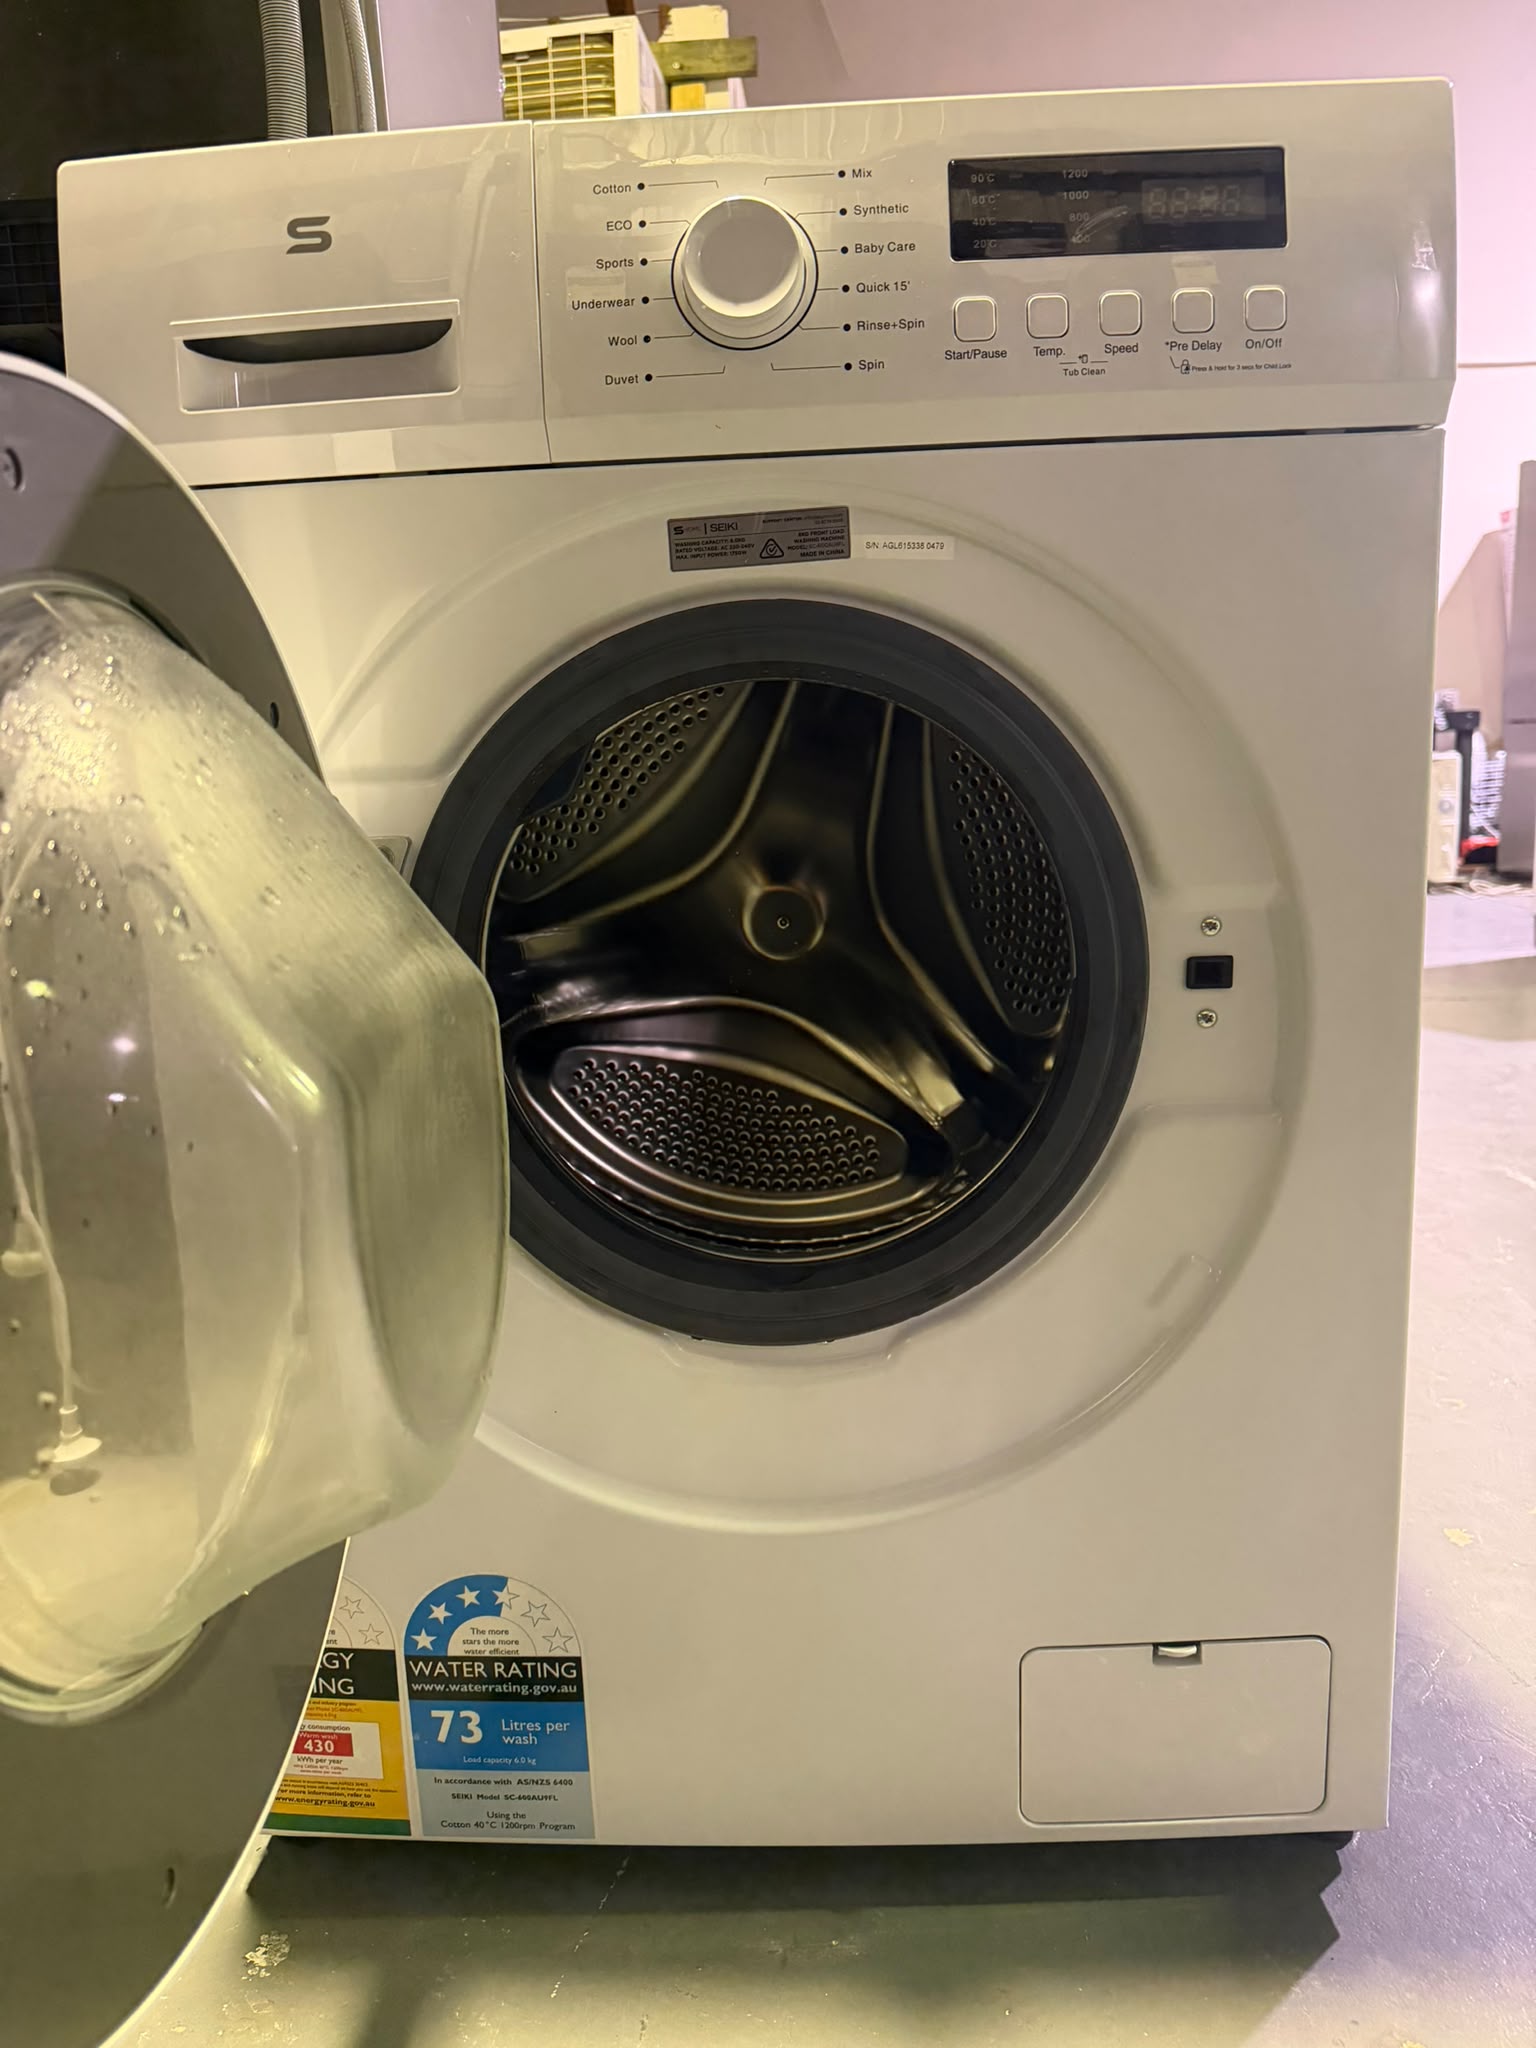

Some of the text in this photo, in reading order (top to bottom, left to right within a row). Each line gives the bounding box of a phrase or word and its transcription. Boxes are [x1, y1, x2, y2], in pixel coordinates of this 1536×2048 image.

[852, 168, 872, 178] Mix
[1062, 168, 1088, 179] 1200
[592, 184, 631, 195] Cotton
[1062, 190, 1089, 200] 1000
[853, 203, 909, 217] Synthetic
[1069, 212, 1089, 222] 800
[606, 219, 632, 231] ECO
[854, 241, 916, 255] Baby Care
[596, 258, 634, 271] Sports
[856, 282, 890, 293] Quick
[571, 298, 635, 311] Underwear
[857, 318, 925, 331] Rinse+Spin
[608, 335, 638, 346] Wool
[1191, 340, 1222, 352] Delay
[1245, 338, 1282, 349] On/Off
[944, 349, 1008, 361] Start/Pause
[1033, 346, 1066, 357] Temp.
[1104, 343, 1139, 356] Speed
[858, 359, 885, 372] Spin
[1063, 367, 1106, 377] Tub Clean
[605, 373, 639, 386] Duvet
[710, 522, 738, 532] SEIKI
[825, 548, 845, 556] CHINA
[470, 1627, 509, 1636] The more
[462, 1638, 481, 1646] stars
[483, 1638, 496, 1646] the
[489, 1647, 520, 1656] efficient
[409, 1660, 577, 1679] WATER RATING
[411, 1682, 577, 1696] www.waterrating.gov.au
[308, 1724, 351, 1732] consumption
[430, 1710, 483, 1744] 73
[501, 1718, 570, 1734] Litres per
[502, 1733, 538, 1745] wash
[303, 1739, 334, 1753] 430
[483, 1757, 512, 1765] capacity
[527, 1757, 537, 1765] kg
[444, 1777, 492, 1785] accordance
[516, 1778, 551, 1786] AS/NZS
[486, 1811, 510, 1820] Using
[440, 1820, 575, 1831] Cotton 40°C 1200rpm Program
